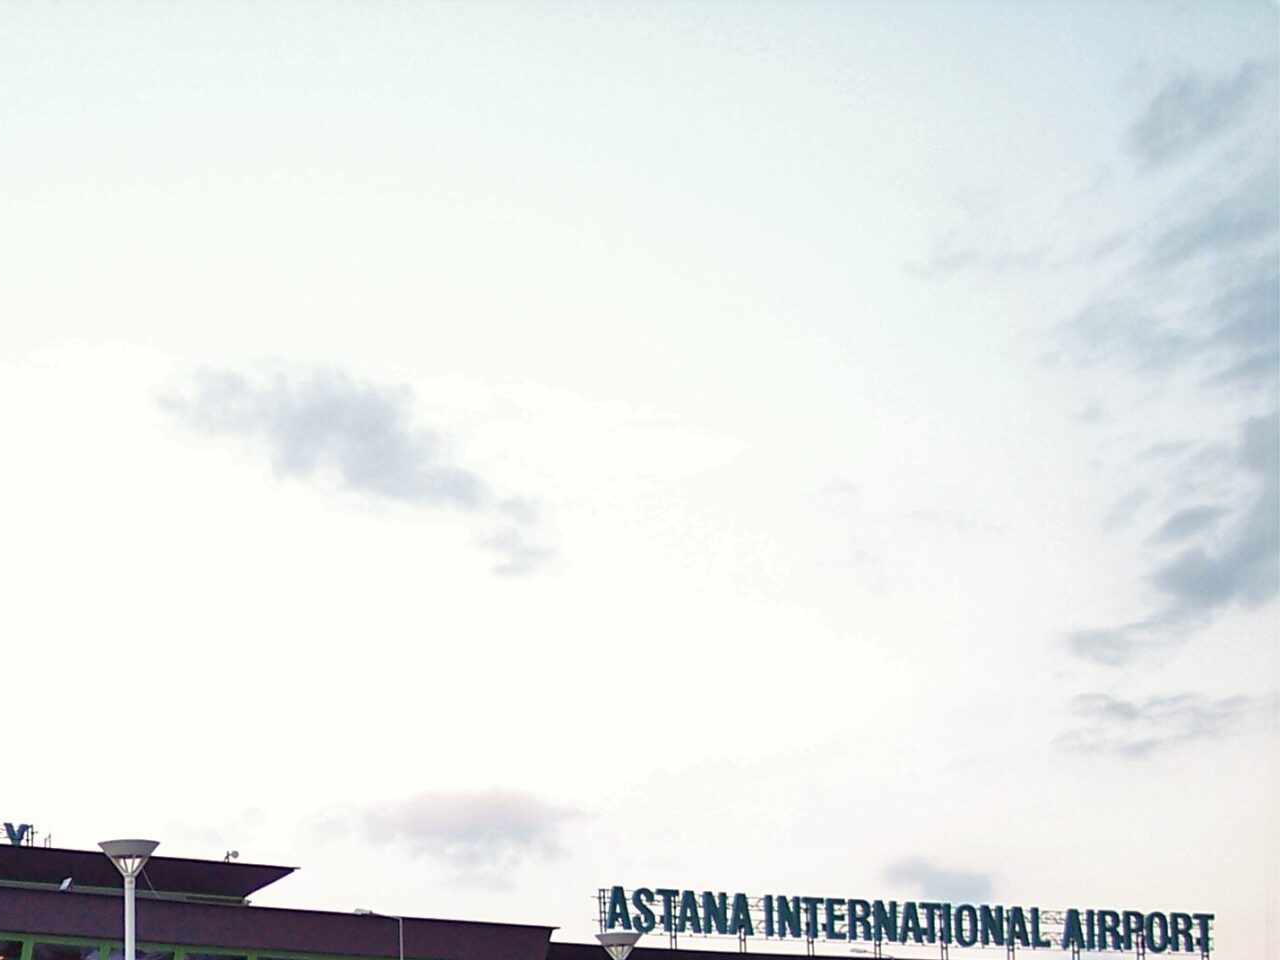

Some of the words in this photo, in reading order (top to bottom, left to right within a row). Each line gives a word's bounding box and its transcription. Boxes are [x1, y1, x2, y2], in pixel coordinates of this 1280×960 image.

[606, 885, 754, 935] ASTANA
[764, 894, 1051, 948] INTERNATIONAL
[1062, 908, 1215, 954] AIRPORT
